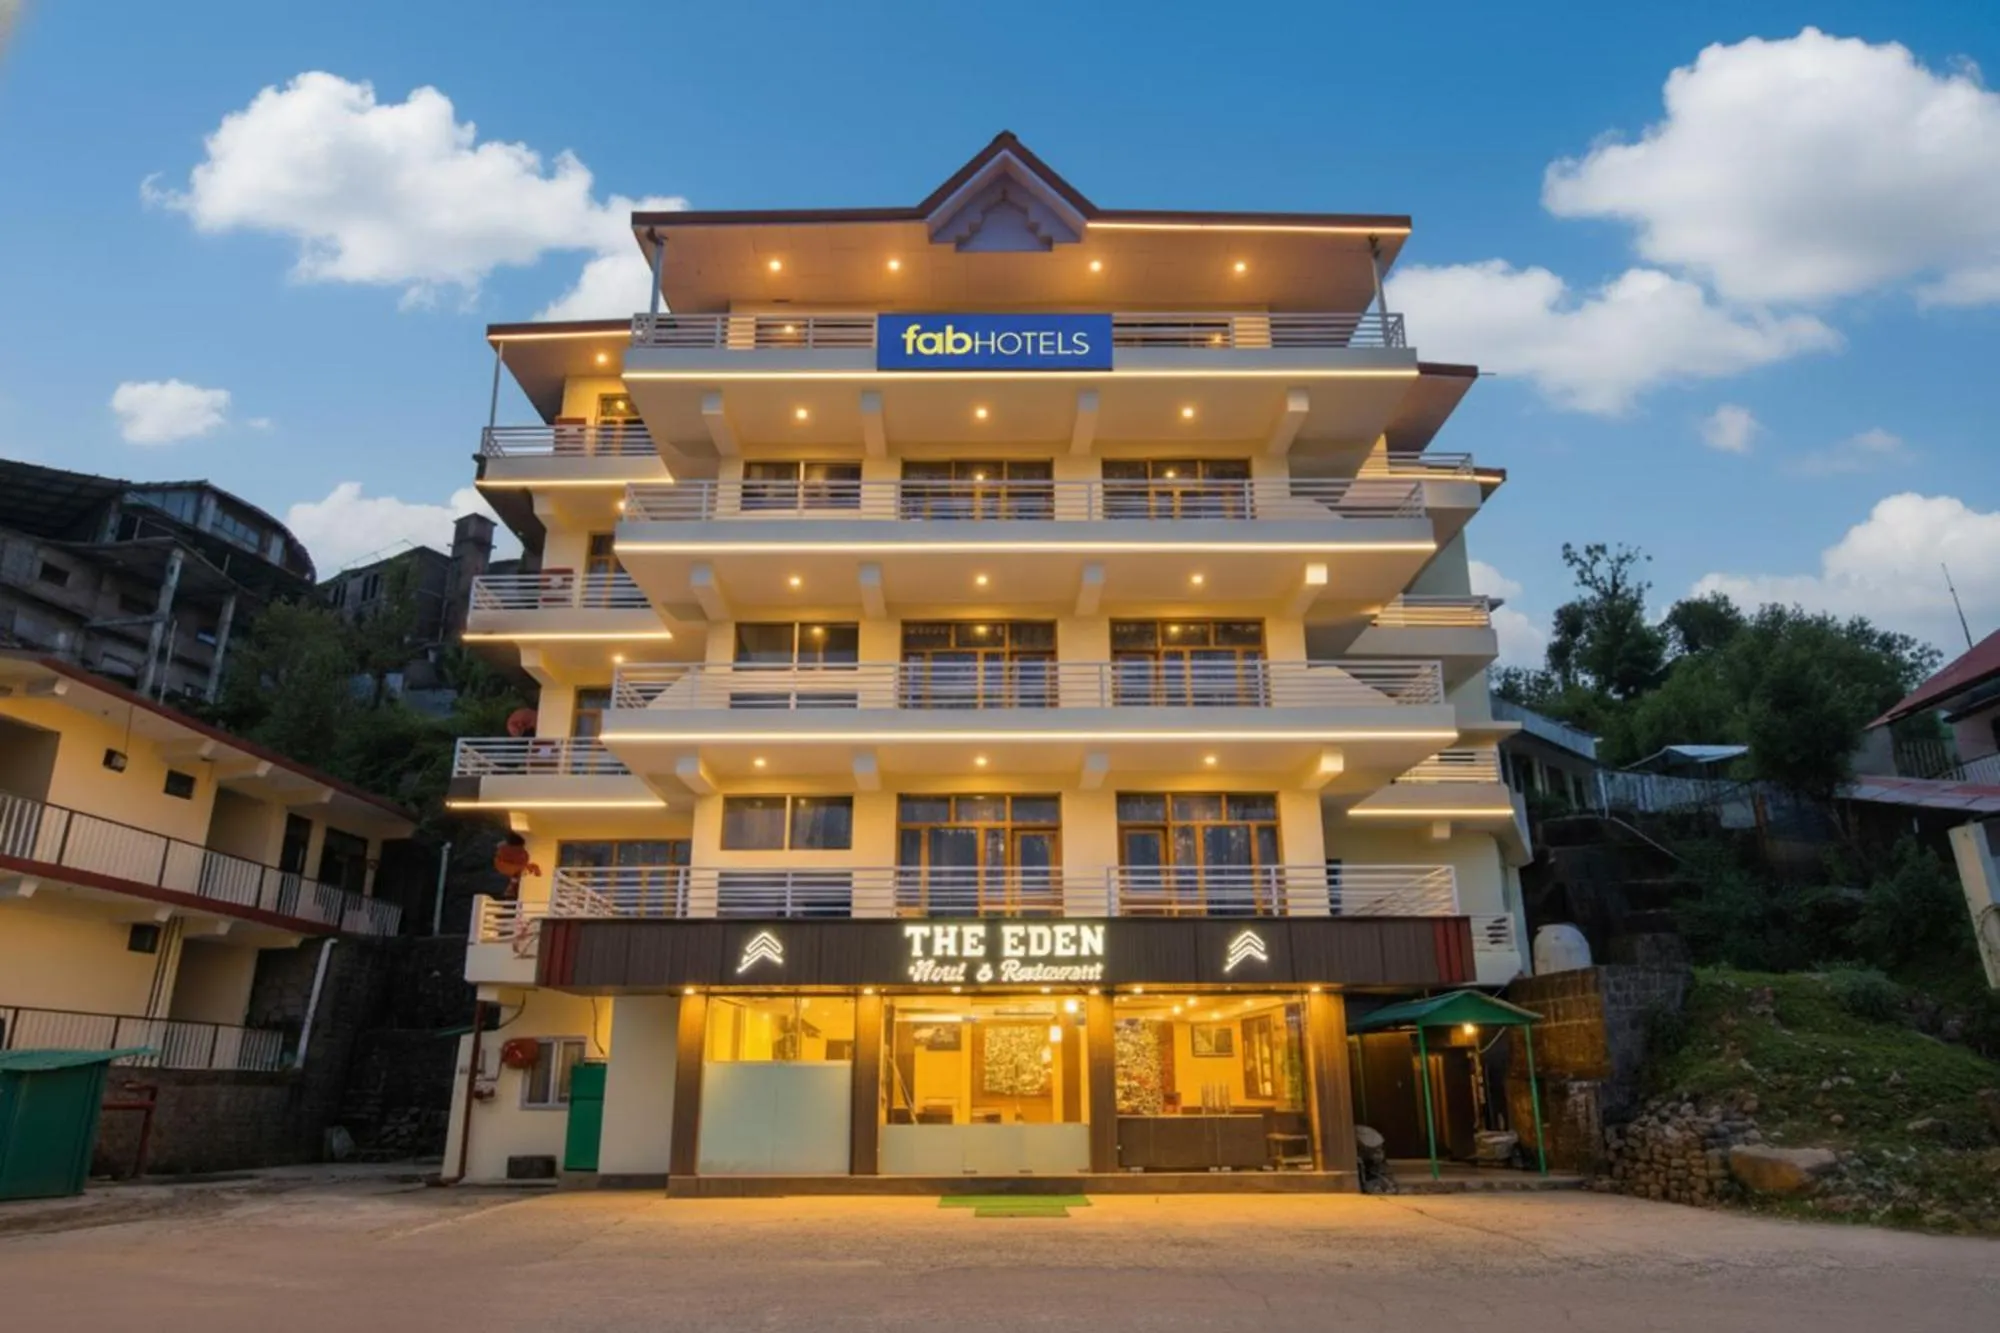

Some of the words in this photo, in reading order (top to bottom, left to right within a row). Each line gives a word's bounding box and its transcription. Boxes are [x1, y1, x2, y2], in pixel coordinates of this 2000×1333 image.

[901, 324, 1090, 355] fabHOTELS
[904, 925, 986, 957] THE
[1001, 925, 1105, 957] EDEN
[976, 963, 994, 982] &
